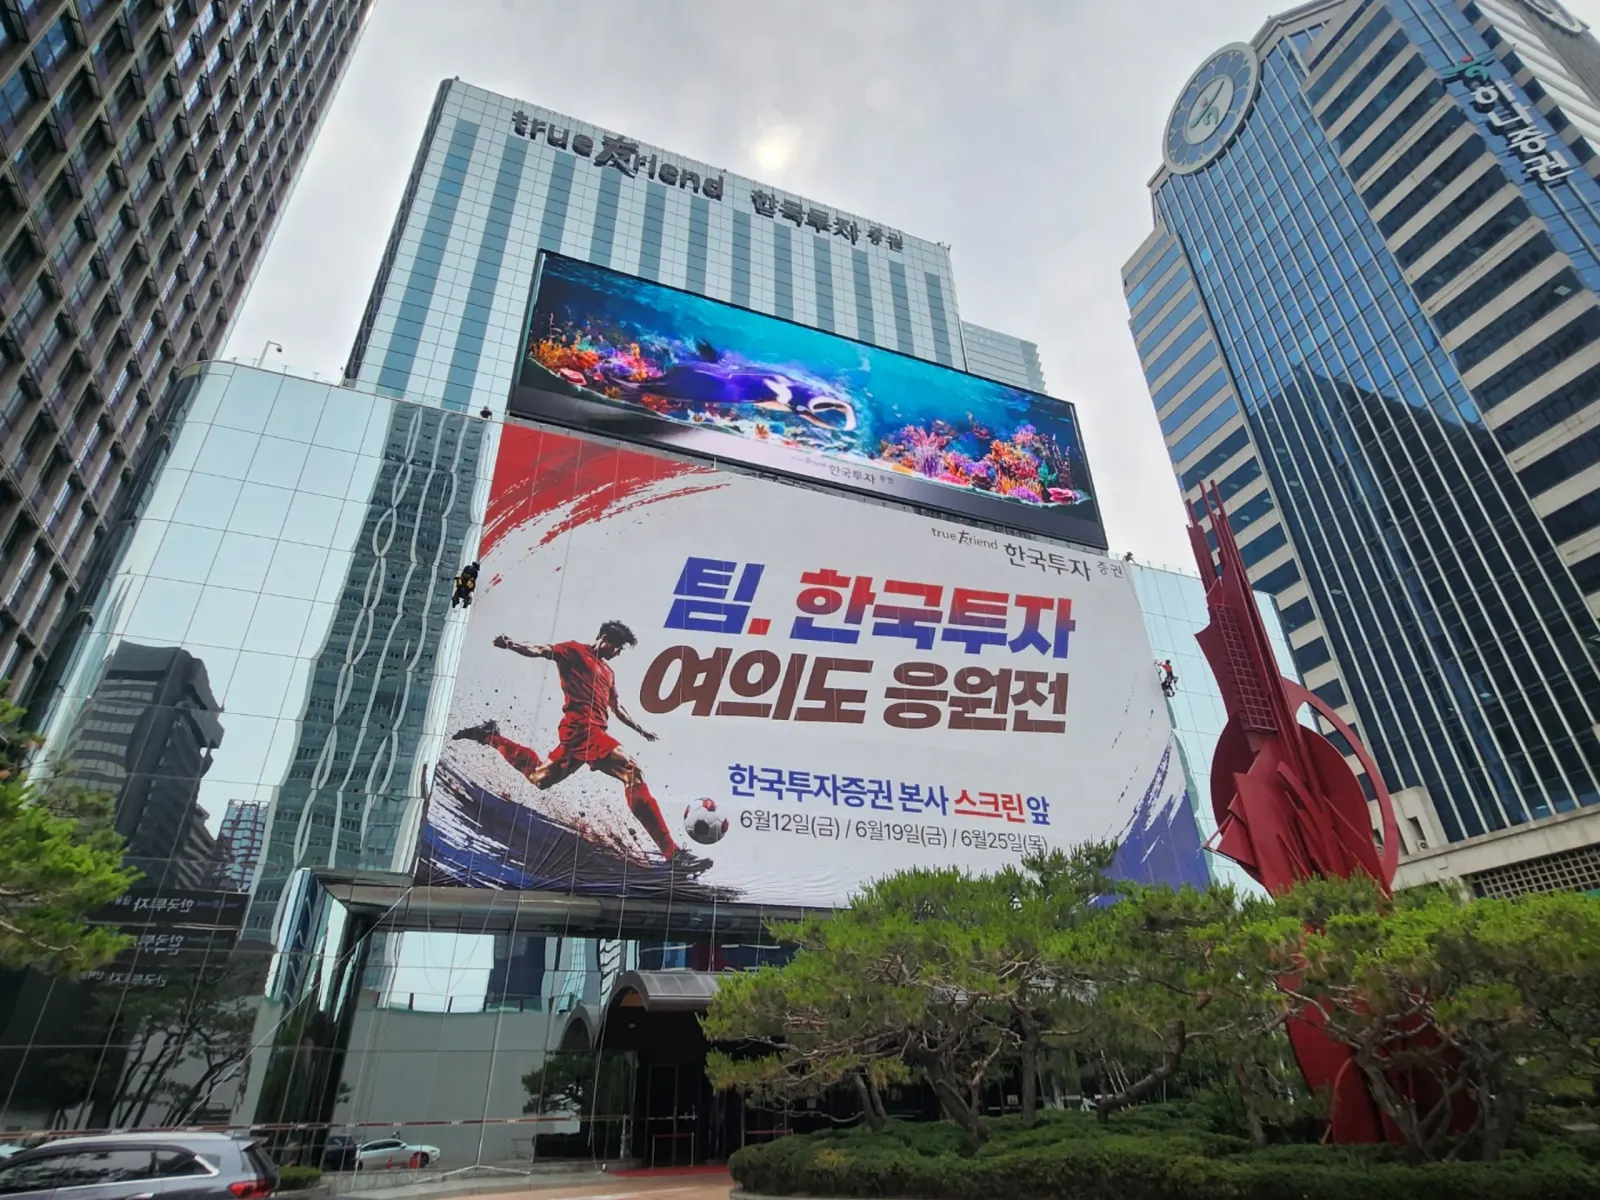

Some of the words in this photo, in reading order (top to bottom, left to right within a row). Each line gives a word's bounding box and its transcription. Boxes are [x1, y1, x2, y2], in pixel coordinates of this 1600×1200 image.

[1470, 80, 1575, 182] 하나증권
[751, 189, 861, 245] 한국투자
[828, 464, 876, 485] 한국투자
[1003, 543, 1091, 581] 한국투자
[1096, 560, 1124, 578] 증권
[663, 556, 772, 636] 팀.
[789, 568, 1076, 659] 한국투자
[639, 645, 874, 725] 여의도
[882, 661, 1069, 734] 응원전
[728, 763, 894, 811] 한국투자증권
[898, 781, 949, 816] 본사
[740, 809, 840, 841] 6월12일(금)
[855, 819, 948, 849] 6월19일(금)
